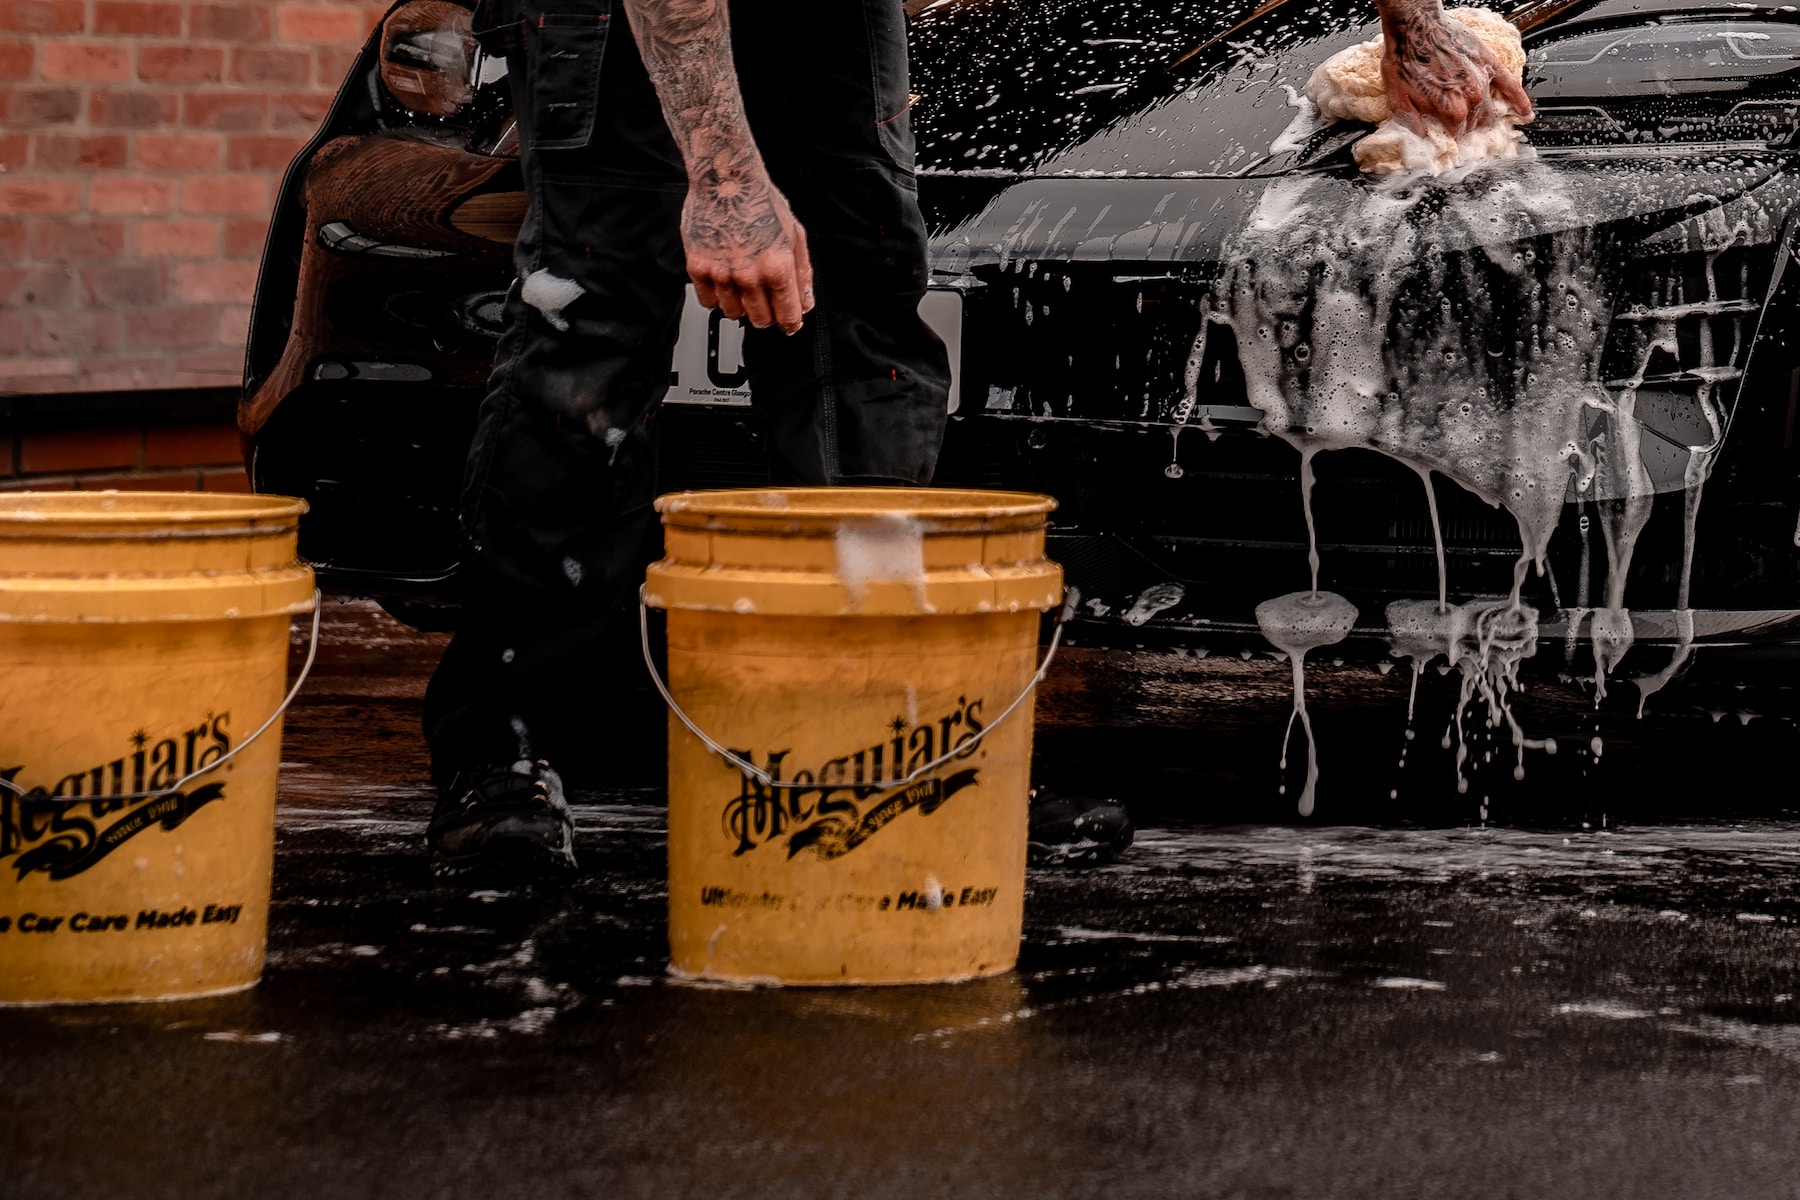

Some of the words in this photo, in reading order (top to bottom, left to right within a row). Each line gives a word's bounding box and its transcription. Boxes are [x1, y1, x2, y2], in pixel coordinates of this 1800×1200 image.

[731, 389, 752, 398] Glasgo
[721, 695, 983, 857] Meguiar's
[895, 889, 955, 911] Mae
[958, 885, 999, 908] Easy
[18, 912, 64, 933] Car
[69, 911, 129, 932] Care
[135, 906, 197, 930] Made
[201, 903, 243, 925] Easy
